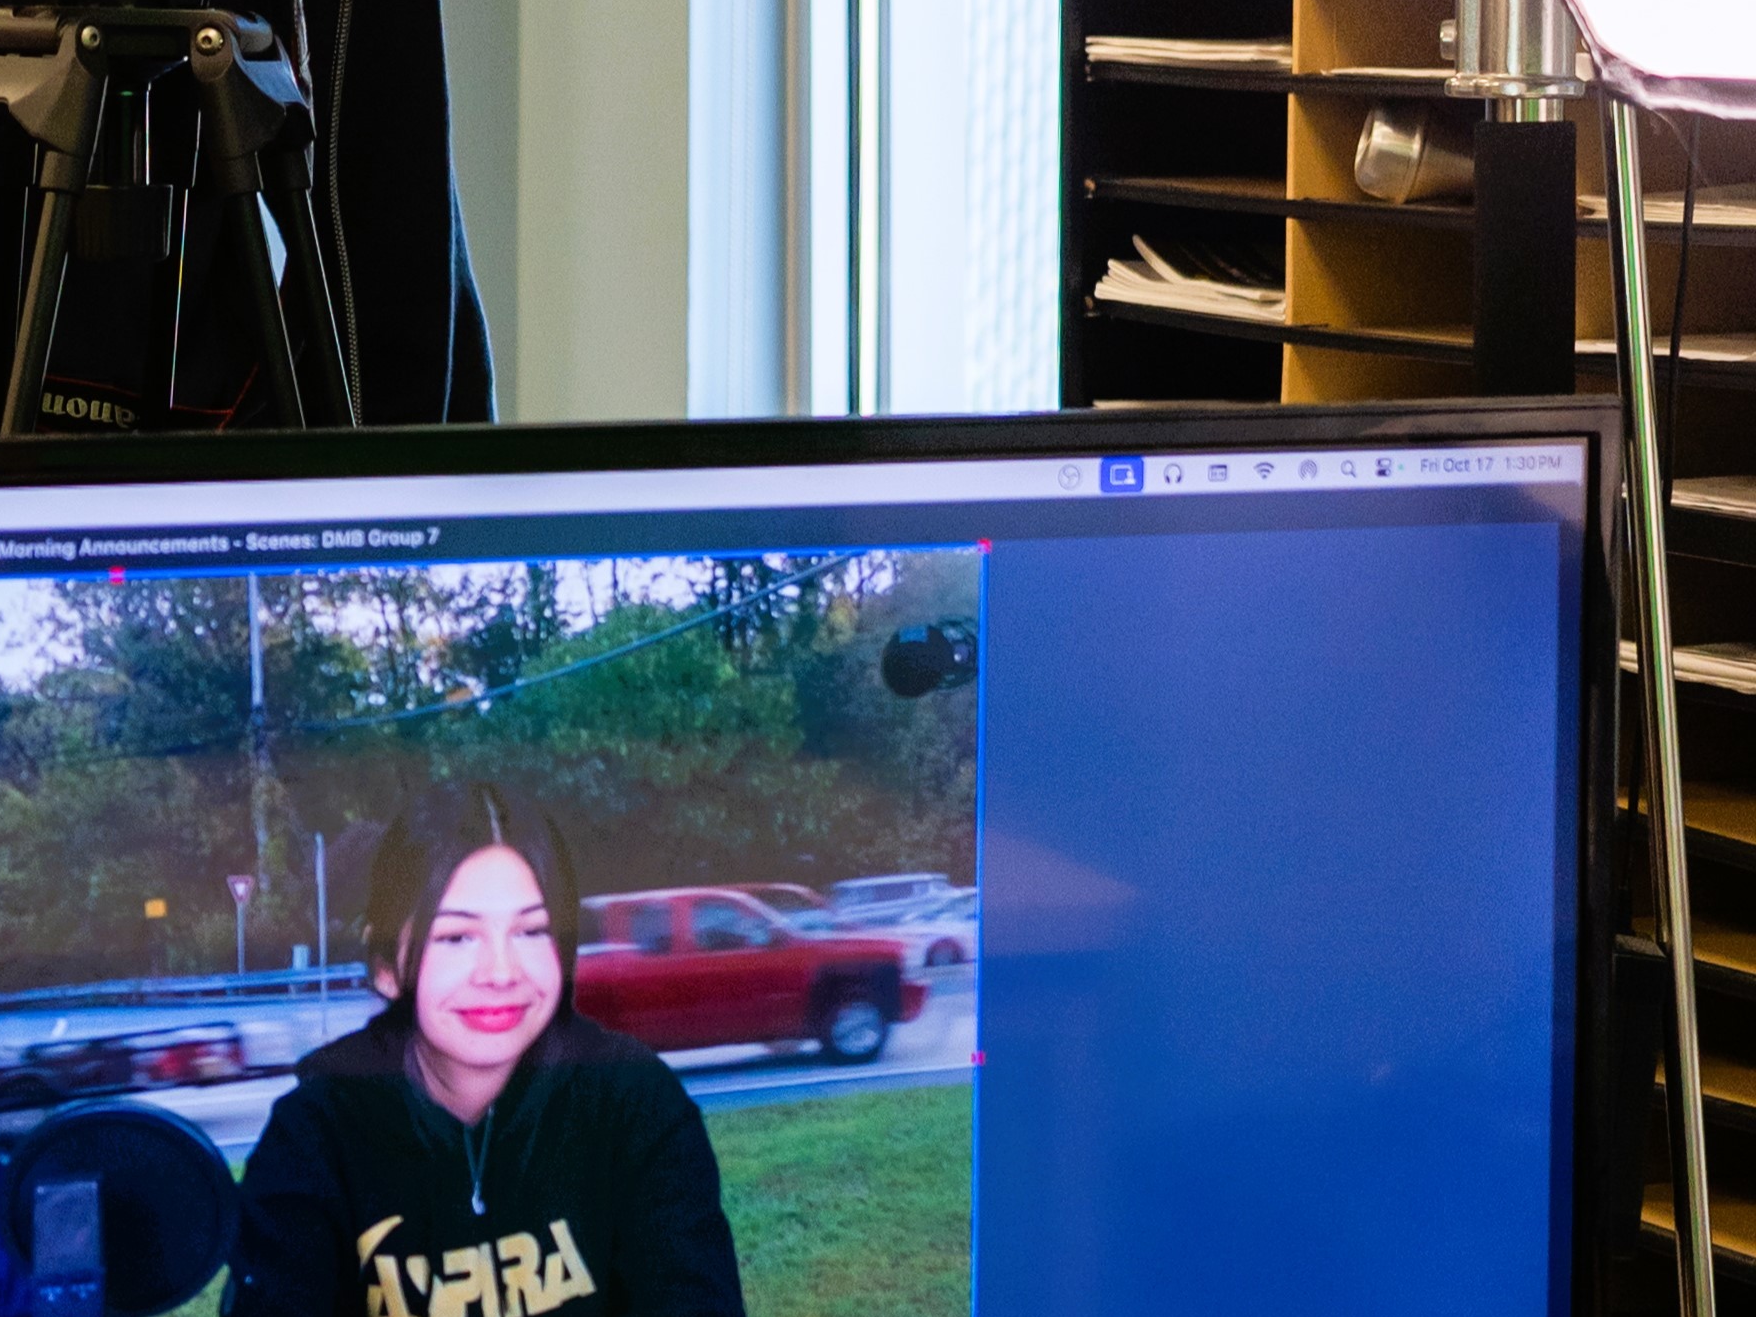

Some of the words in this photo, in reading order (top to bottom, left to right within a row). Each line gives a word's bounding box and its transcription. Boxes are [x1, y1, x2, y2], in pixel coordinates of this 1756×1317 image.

[1420, 458, 1439, 472] Fri
[1443, 458, 1470, 472] Oct
[1477, 457, 1493, 471] 17
[78, 535, 230, 557] Announcements
[245, 531, 320, 551] Scenes:
[368, 527, 425, 549] Group
[427, 526, 441, 545] 7
